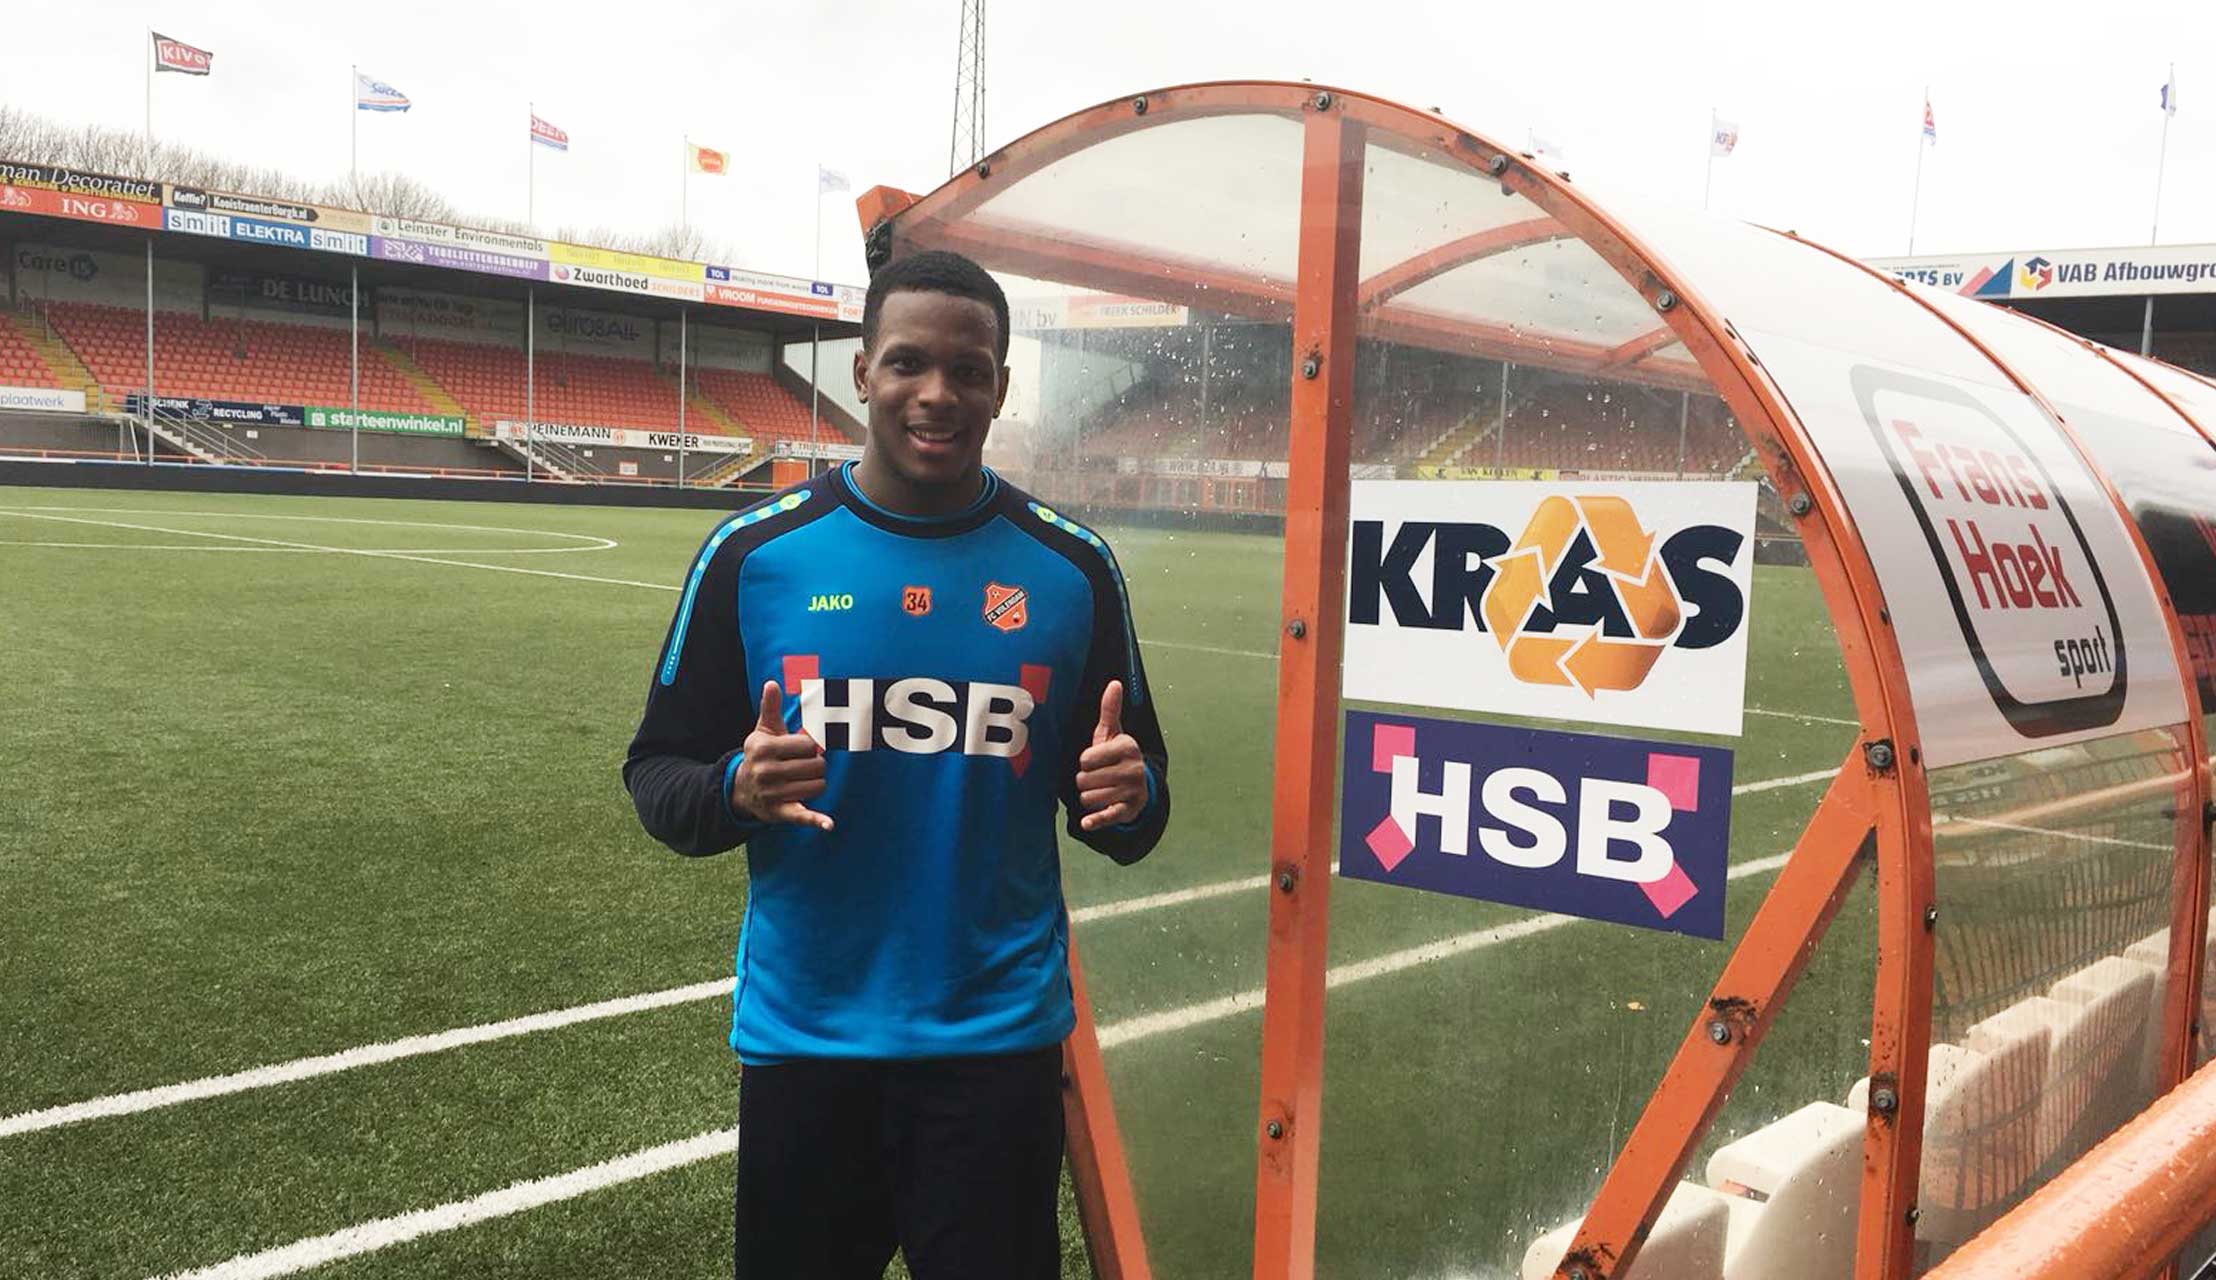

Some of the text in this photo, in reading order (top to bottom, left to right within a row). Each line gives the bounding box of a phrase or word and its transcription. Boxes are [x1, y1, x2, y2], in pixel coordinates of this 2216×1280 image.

[51, 168, 155, 197] Decoratief
[62, 198, 107, 218] ING
[170, 214, 230, 237] smit
[236, 223, 304, 244] ELEKTRA
[312, 233, 367, 253] smit
[398, 218, 448, 237] Leinster
[454, 229, 544, 251] Environmentals
[574, 267, 648, 290] Zwarthoed
[1943, 272, 1964, 286] BV
[2058, 263, 2097, 283] VAB
[718, 289, 756, 303] VROOM
[213, 408, 263, 420] RECYCLING
[330, 411, 464, 433] starteenwinkel.nl
[1891, 418, 2049, 511] Frans
[1946, 518, 2083, 610] Hoek
[1349, 520, 1745, 650] KRAS
[808, 593, 854, 612] JAKO
[905, 591, 930, 612] 34
[2053, 624, 2112, 688] sport
[800, 677, 1036, 758] HSB
[1390, 755, 1675, 884] HSB
